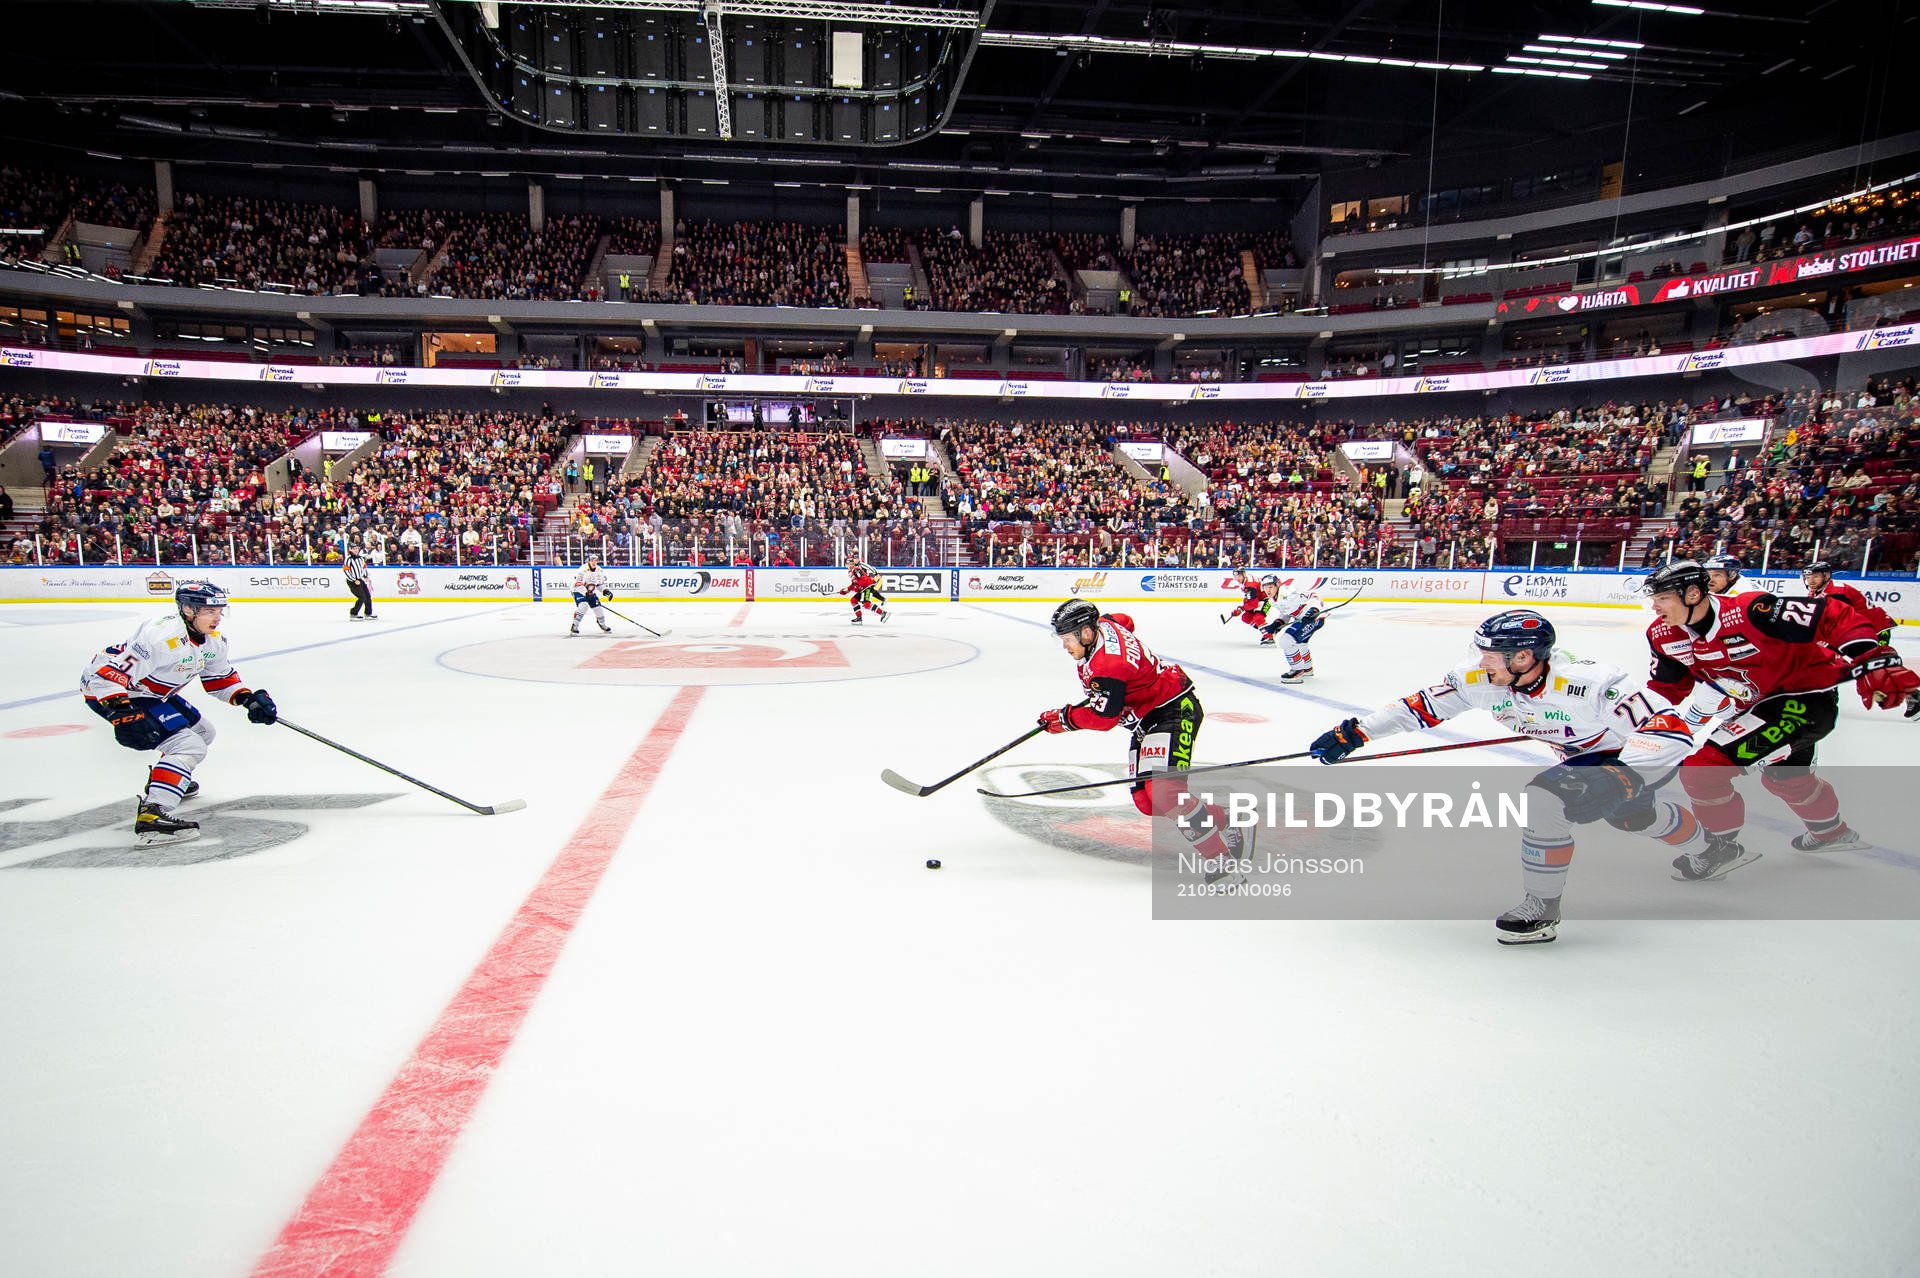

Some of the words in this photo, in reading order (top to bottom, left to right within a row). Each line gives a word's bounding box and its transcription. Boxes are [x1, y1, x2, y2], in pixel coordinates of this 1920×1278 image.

[1839, 241, 1920, 270] STOLTHET
[1693, 271, 1758, 294] KVALITET
[1581, 291, 1627, 309] HJÄRTA
[1873, 327, 1915, 339] Svensk
[1878, 337, 1910, 347] Cater
[2, 350, 34, 359] Svensk
[1692, 352, 1725, 361] Svensk
[8, 357, 32, 366] Cater
[154, 362, 180, 370] Svensk
[1696, 360, 1721, 369] Cater
[159, 368, 179, 376] Cater
[1543, 368, 1571, 376] Svensk
[1545, 374, 1567, 382] Cater
[250, 576, 330, 588] sandberg
[660, 578, 698, 588] SUPER
[711, 579, 740, 588] DAEK
[882, 574, 940, 592] RSA
[1071, 572, 1107, 594] guld
[1157, 574, 1198, 582] HÖGTRYCKS
[1331, 577, 1374, 586] Climat80
[1525, 574, 1568, 588] EKDAHL
[480, 583, 505, 591] UNGDOM
[774, 582, 834, 595] SportsClub
[1157, 581, 1182, 589] TJÄNST
[1391, 577, 1470, 593] navigator
[1523, 586, 1549, 599] MILJÖ
[1552, 588, 1567, 598] AB
[1782, 601, 1817, 628] 22
[1851, 656, 1901, 678] CCM
[1567, 683, 1588, 698] put
[111, 712, 144, 726] CCM
[1545, 709, 1572, 722] wilo
[1518, 726, 1560, 736] Karlsson
